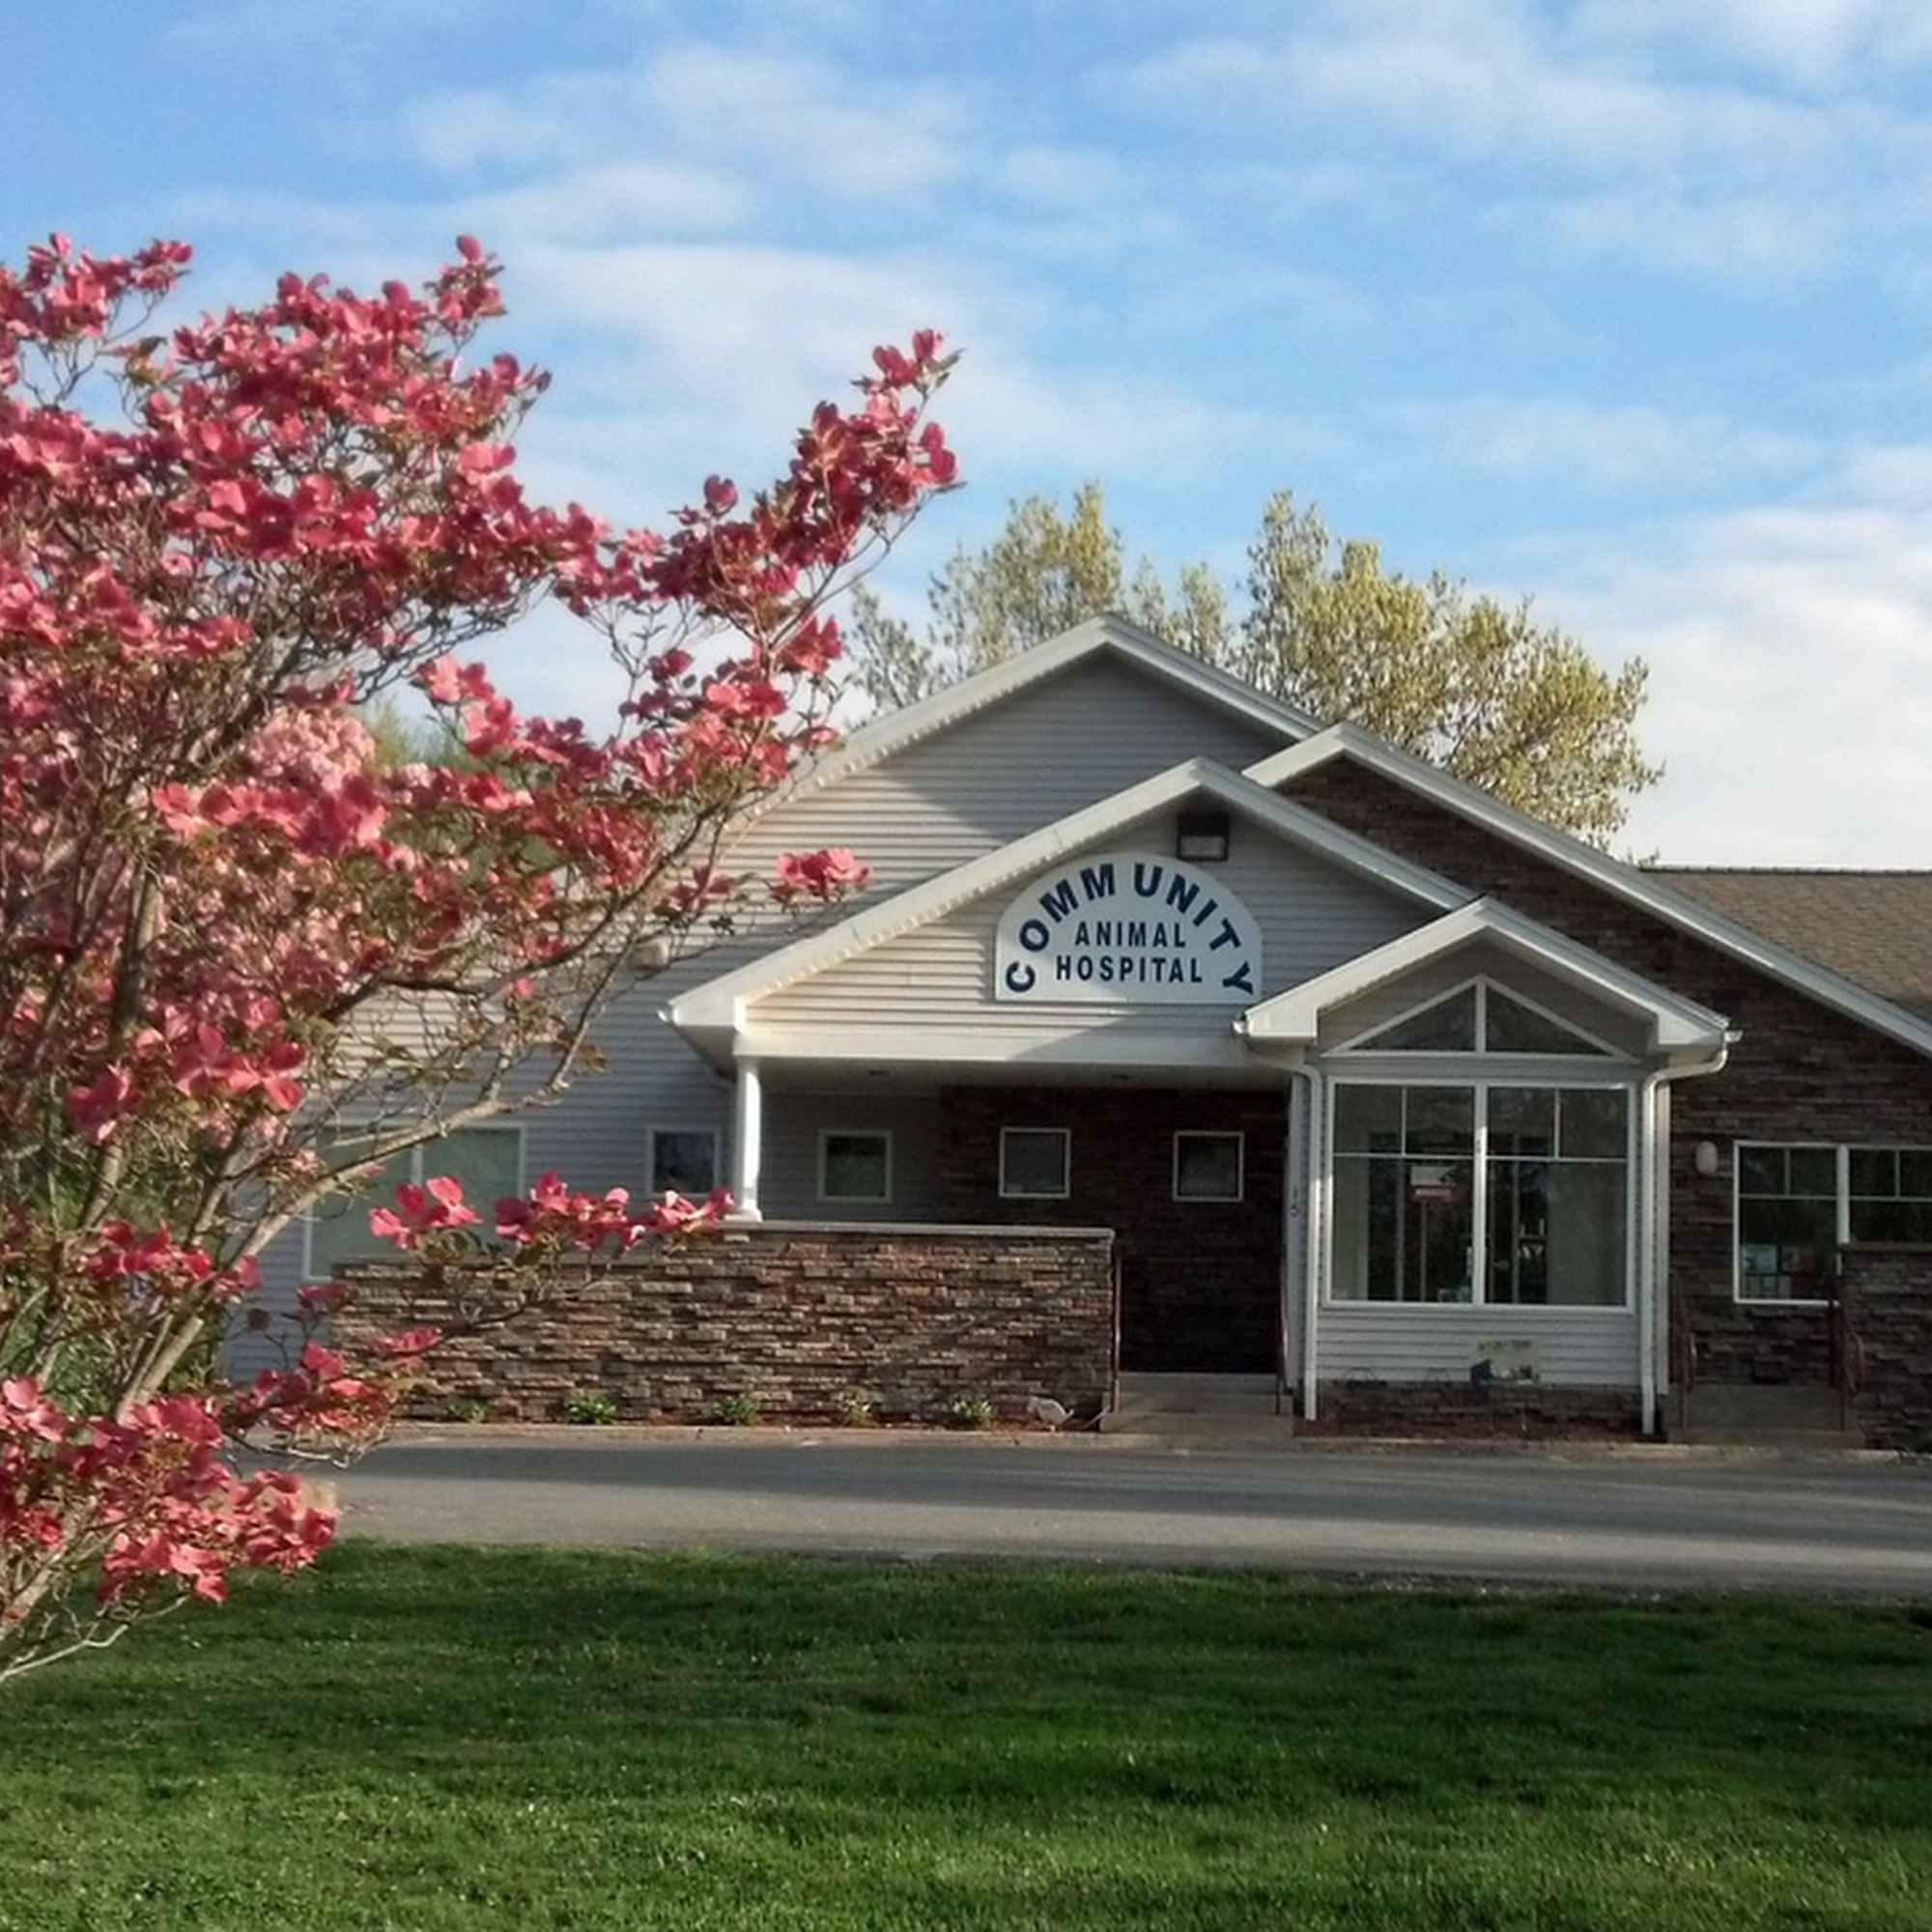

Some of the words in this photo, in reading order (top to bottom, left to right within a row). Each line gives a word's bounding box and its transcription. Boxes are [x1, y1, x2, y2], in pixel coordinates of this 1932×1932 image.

[1006, 864, 1253, 995] COMMUNITY
[1075, 921, 1186, 948] ANIMAL
[1056, 954, 1202, 983] HOSPITAL
